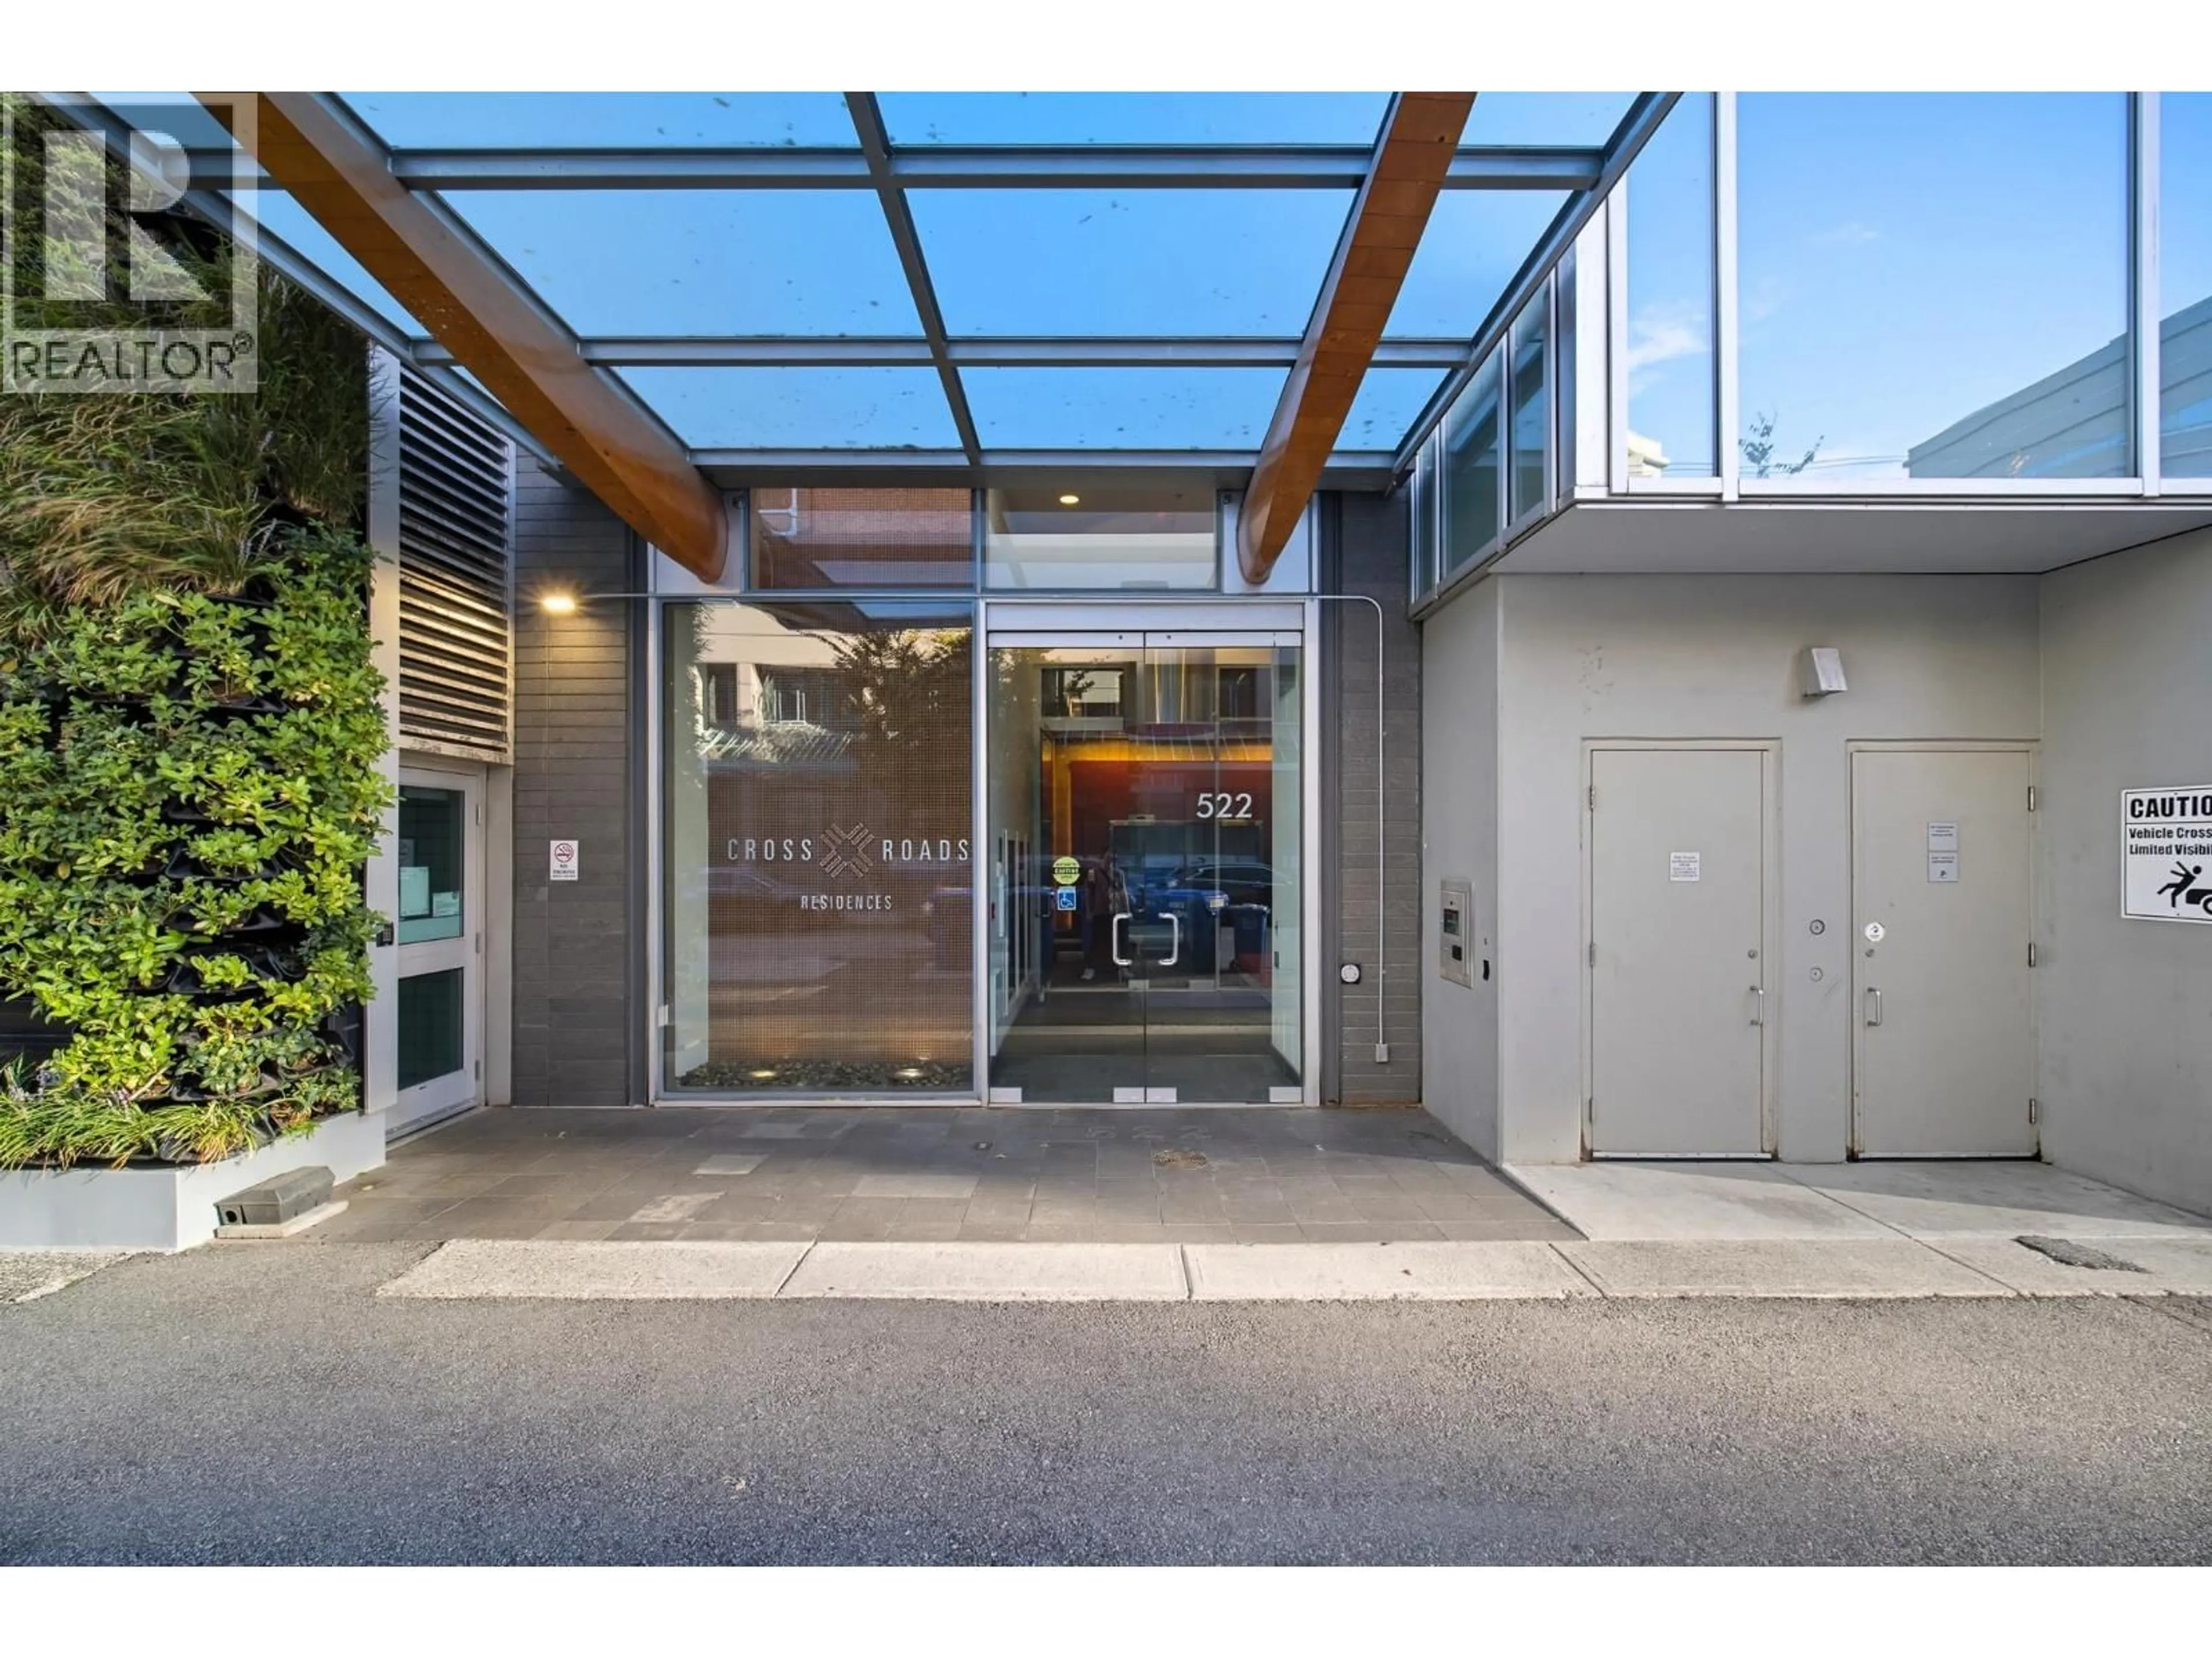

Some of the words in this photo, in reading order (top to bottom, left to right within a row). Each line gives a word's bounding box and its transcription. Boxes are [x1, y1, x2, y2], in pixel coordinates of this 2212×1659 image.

[1196, 793, 1253, 819] 522
[2129, 828, 2173, 839] Vehicle
[728, 839, 812, 861] CROSS
[882, 839, 968, 861] ROADS
[2129, 844, 2172, 855] Limited
[801, 895, 892, 910] RESIDENCES
